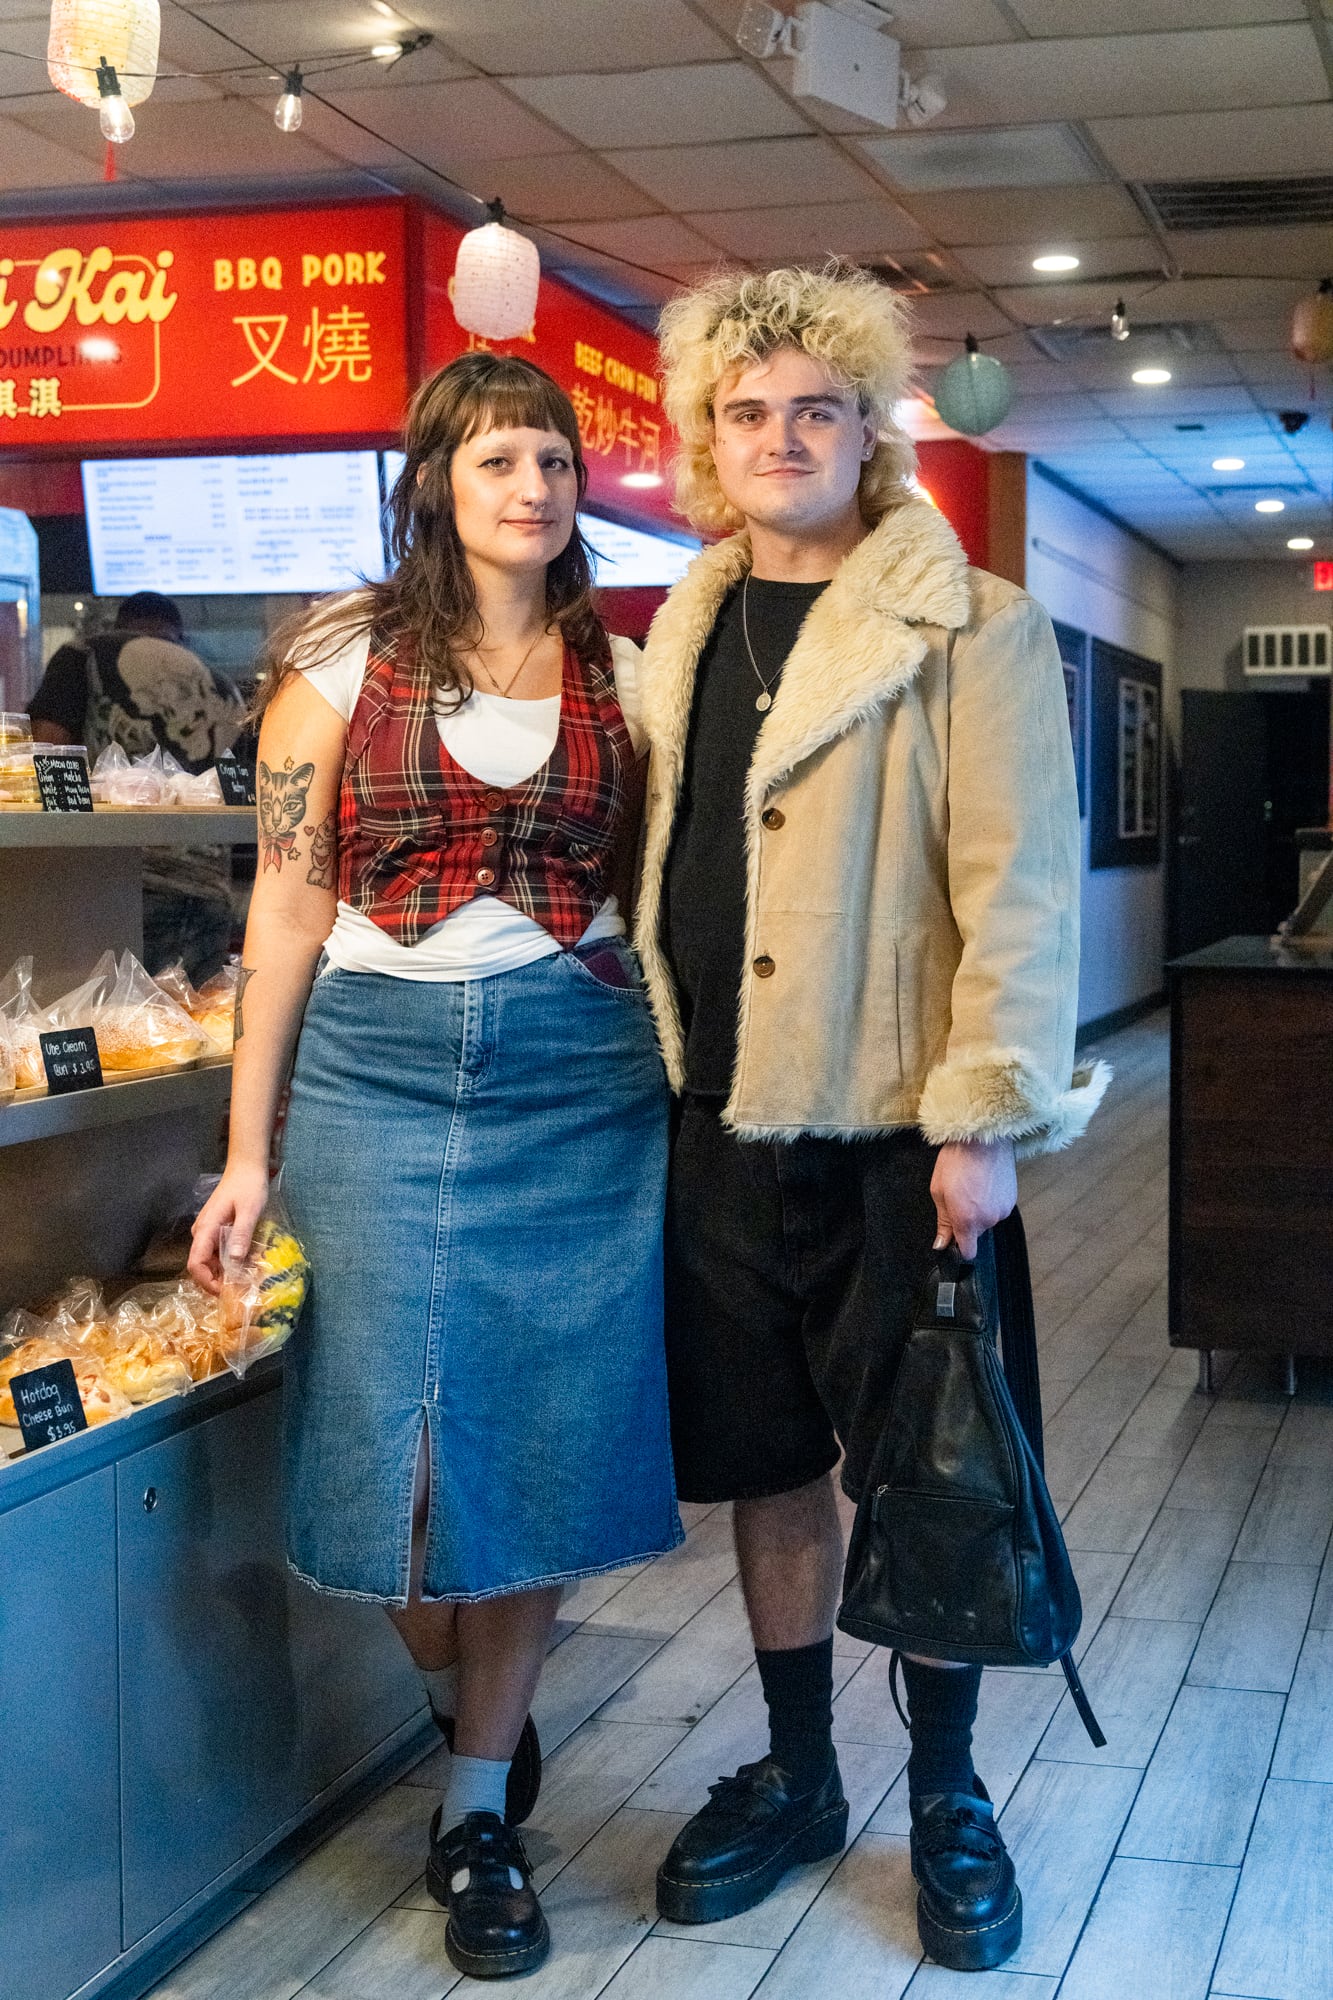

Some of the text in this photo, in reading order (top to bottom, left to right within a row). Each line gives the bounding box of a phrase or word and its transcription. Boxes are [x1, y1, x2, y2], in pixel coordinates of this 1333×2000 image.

[214, 251, 387, 292] BBQ PORK
[24, 246, 178, 333] Kai
[231, 304, 372, 388] 叉燒
[62, 1040, 88, 1053] Cream
[20, 1381, 62, 1406] Hotdog
[22, 1403, 74, 1428] Cheese Bun
[46, 1420, 77, 1442] $3.95
